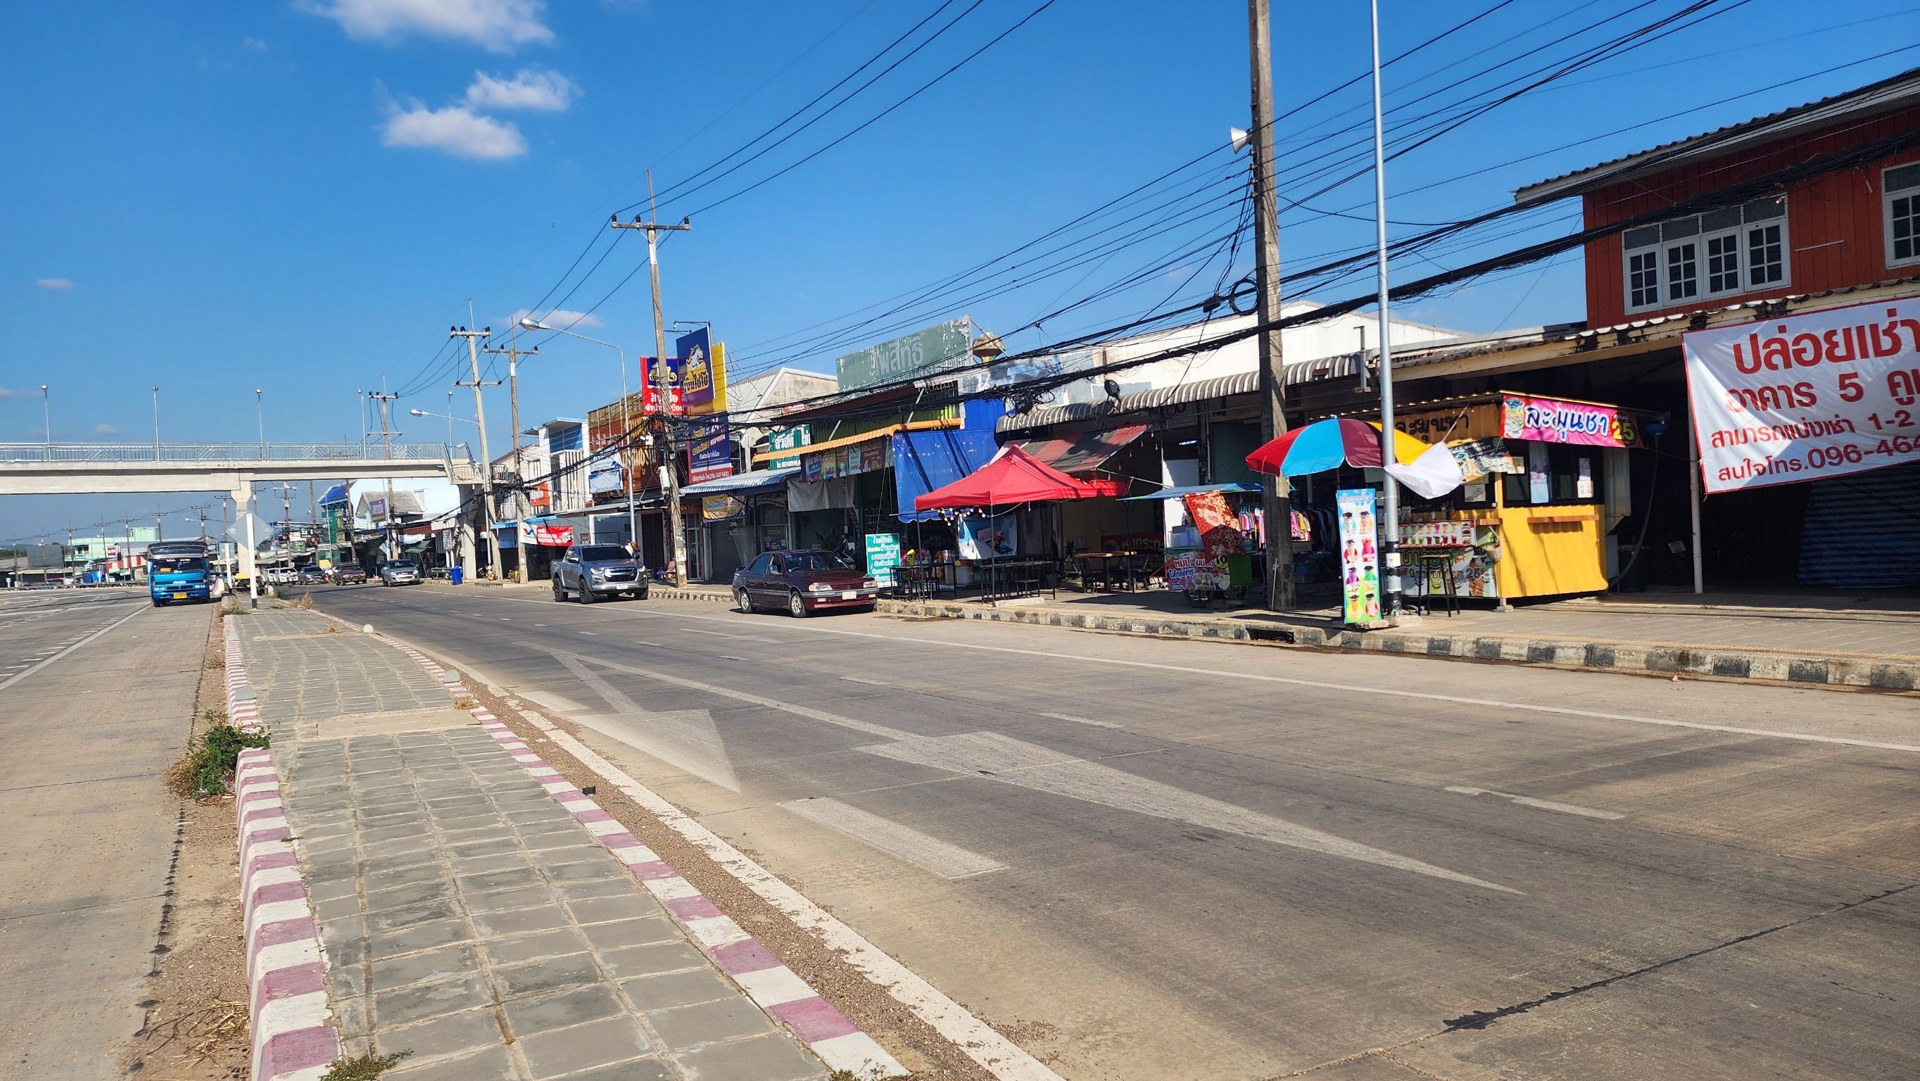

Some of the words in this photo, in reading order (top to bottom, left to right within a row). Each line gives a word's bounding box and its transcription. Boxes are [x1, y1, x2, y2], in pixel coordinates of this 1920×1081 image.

[1732, 308, 1920, 375] ปล่อยเช่า
[1725, 381, 1818, 413] อาคาร
[1838, 372, 1864, 402] 5
[1526, 406, 1609, 442] ละมุนชา
[1611, 421, 1635, 441] 25
[1711, 414, 1856, 448] สามารถแบ่งเช่า
[1868, 410, 1915, 431] 1-2
